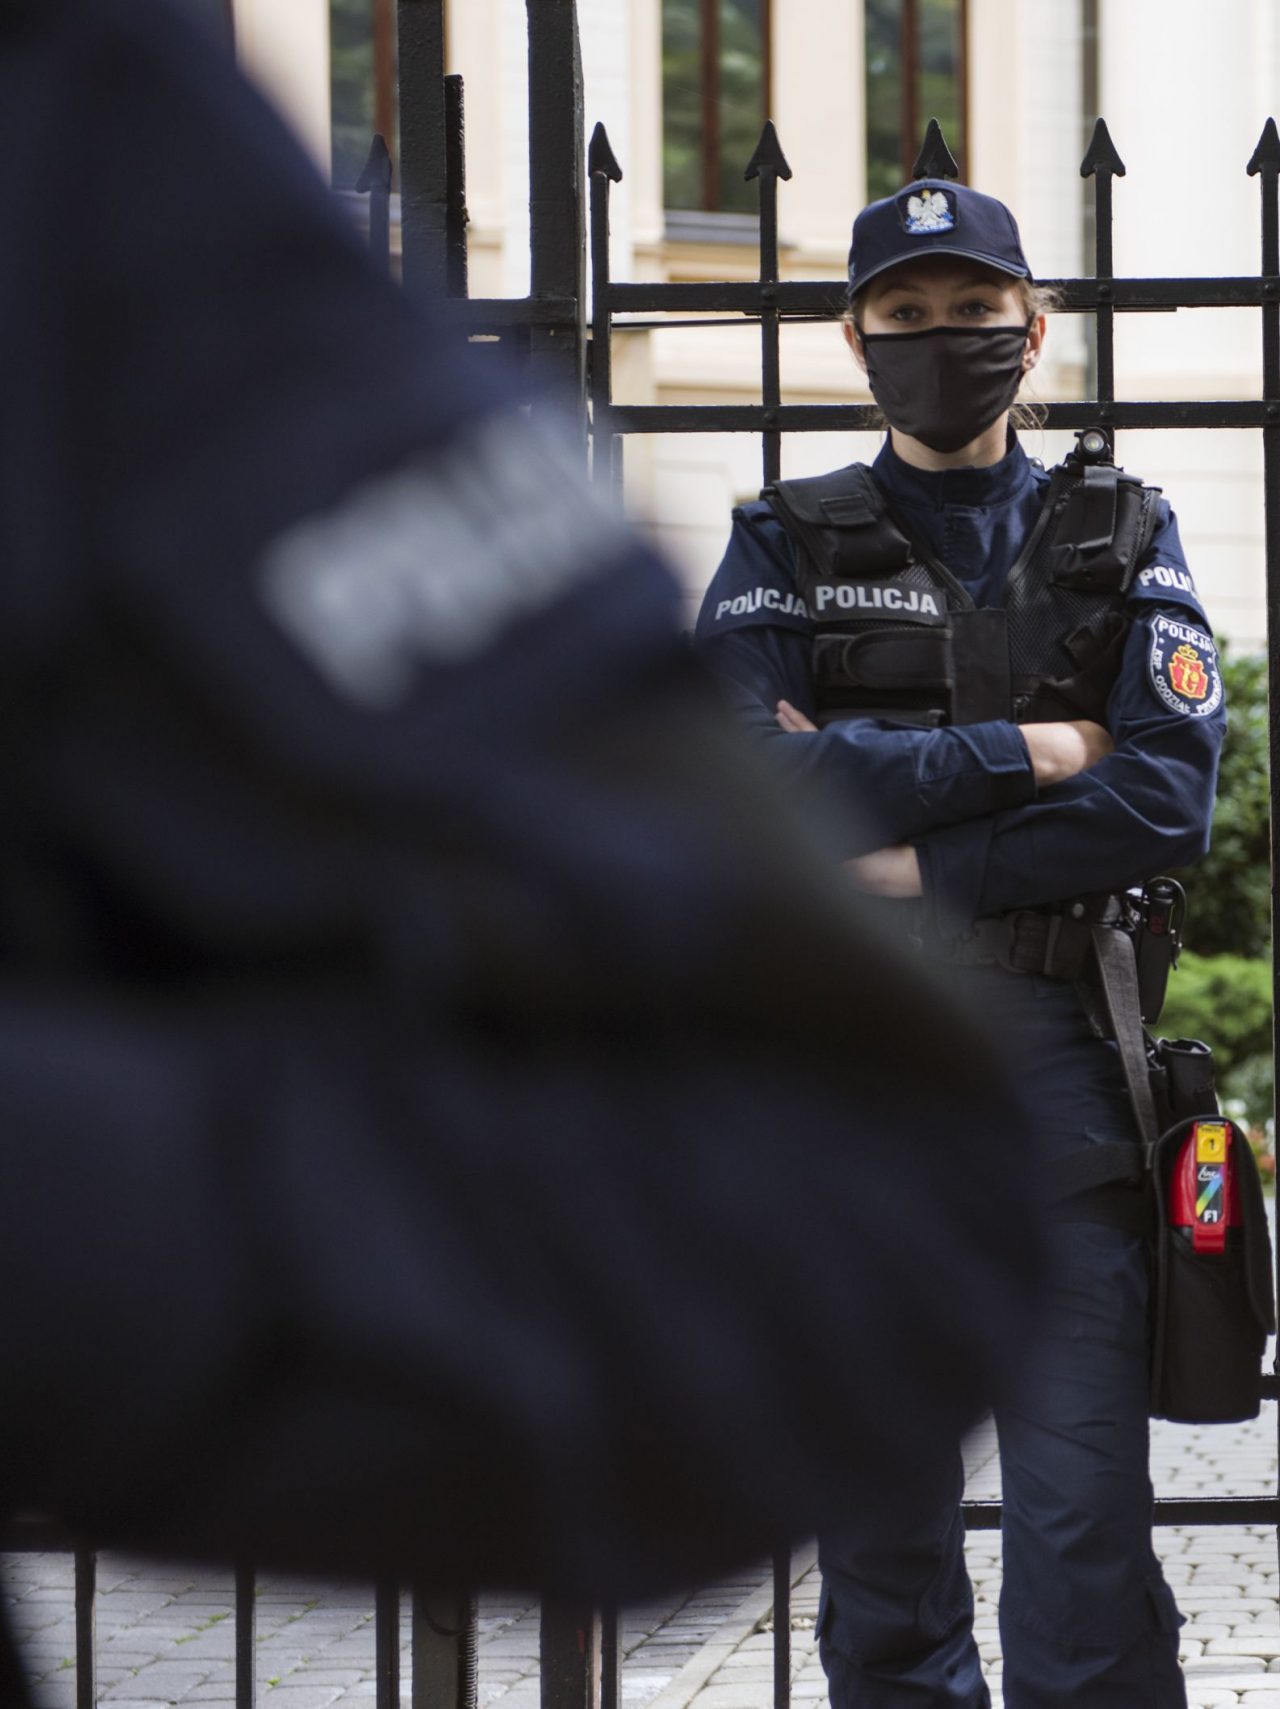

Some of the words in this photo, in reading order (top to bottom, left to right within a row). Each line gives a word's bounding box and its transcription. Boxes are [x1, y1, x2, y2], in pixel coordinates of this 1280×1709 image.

[714, 586, 808, 621] POLICJA
[814, 585, 940, 617] POLICJA
[1158, 619, 1215, 654] POLICJA
[1203, 1209, 1218, 1223] F1
